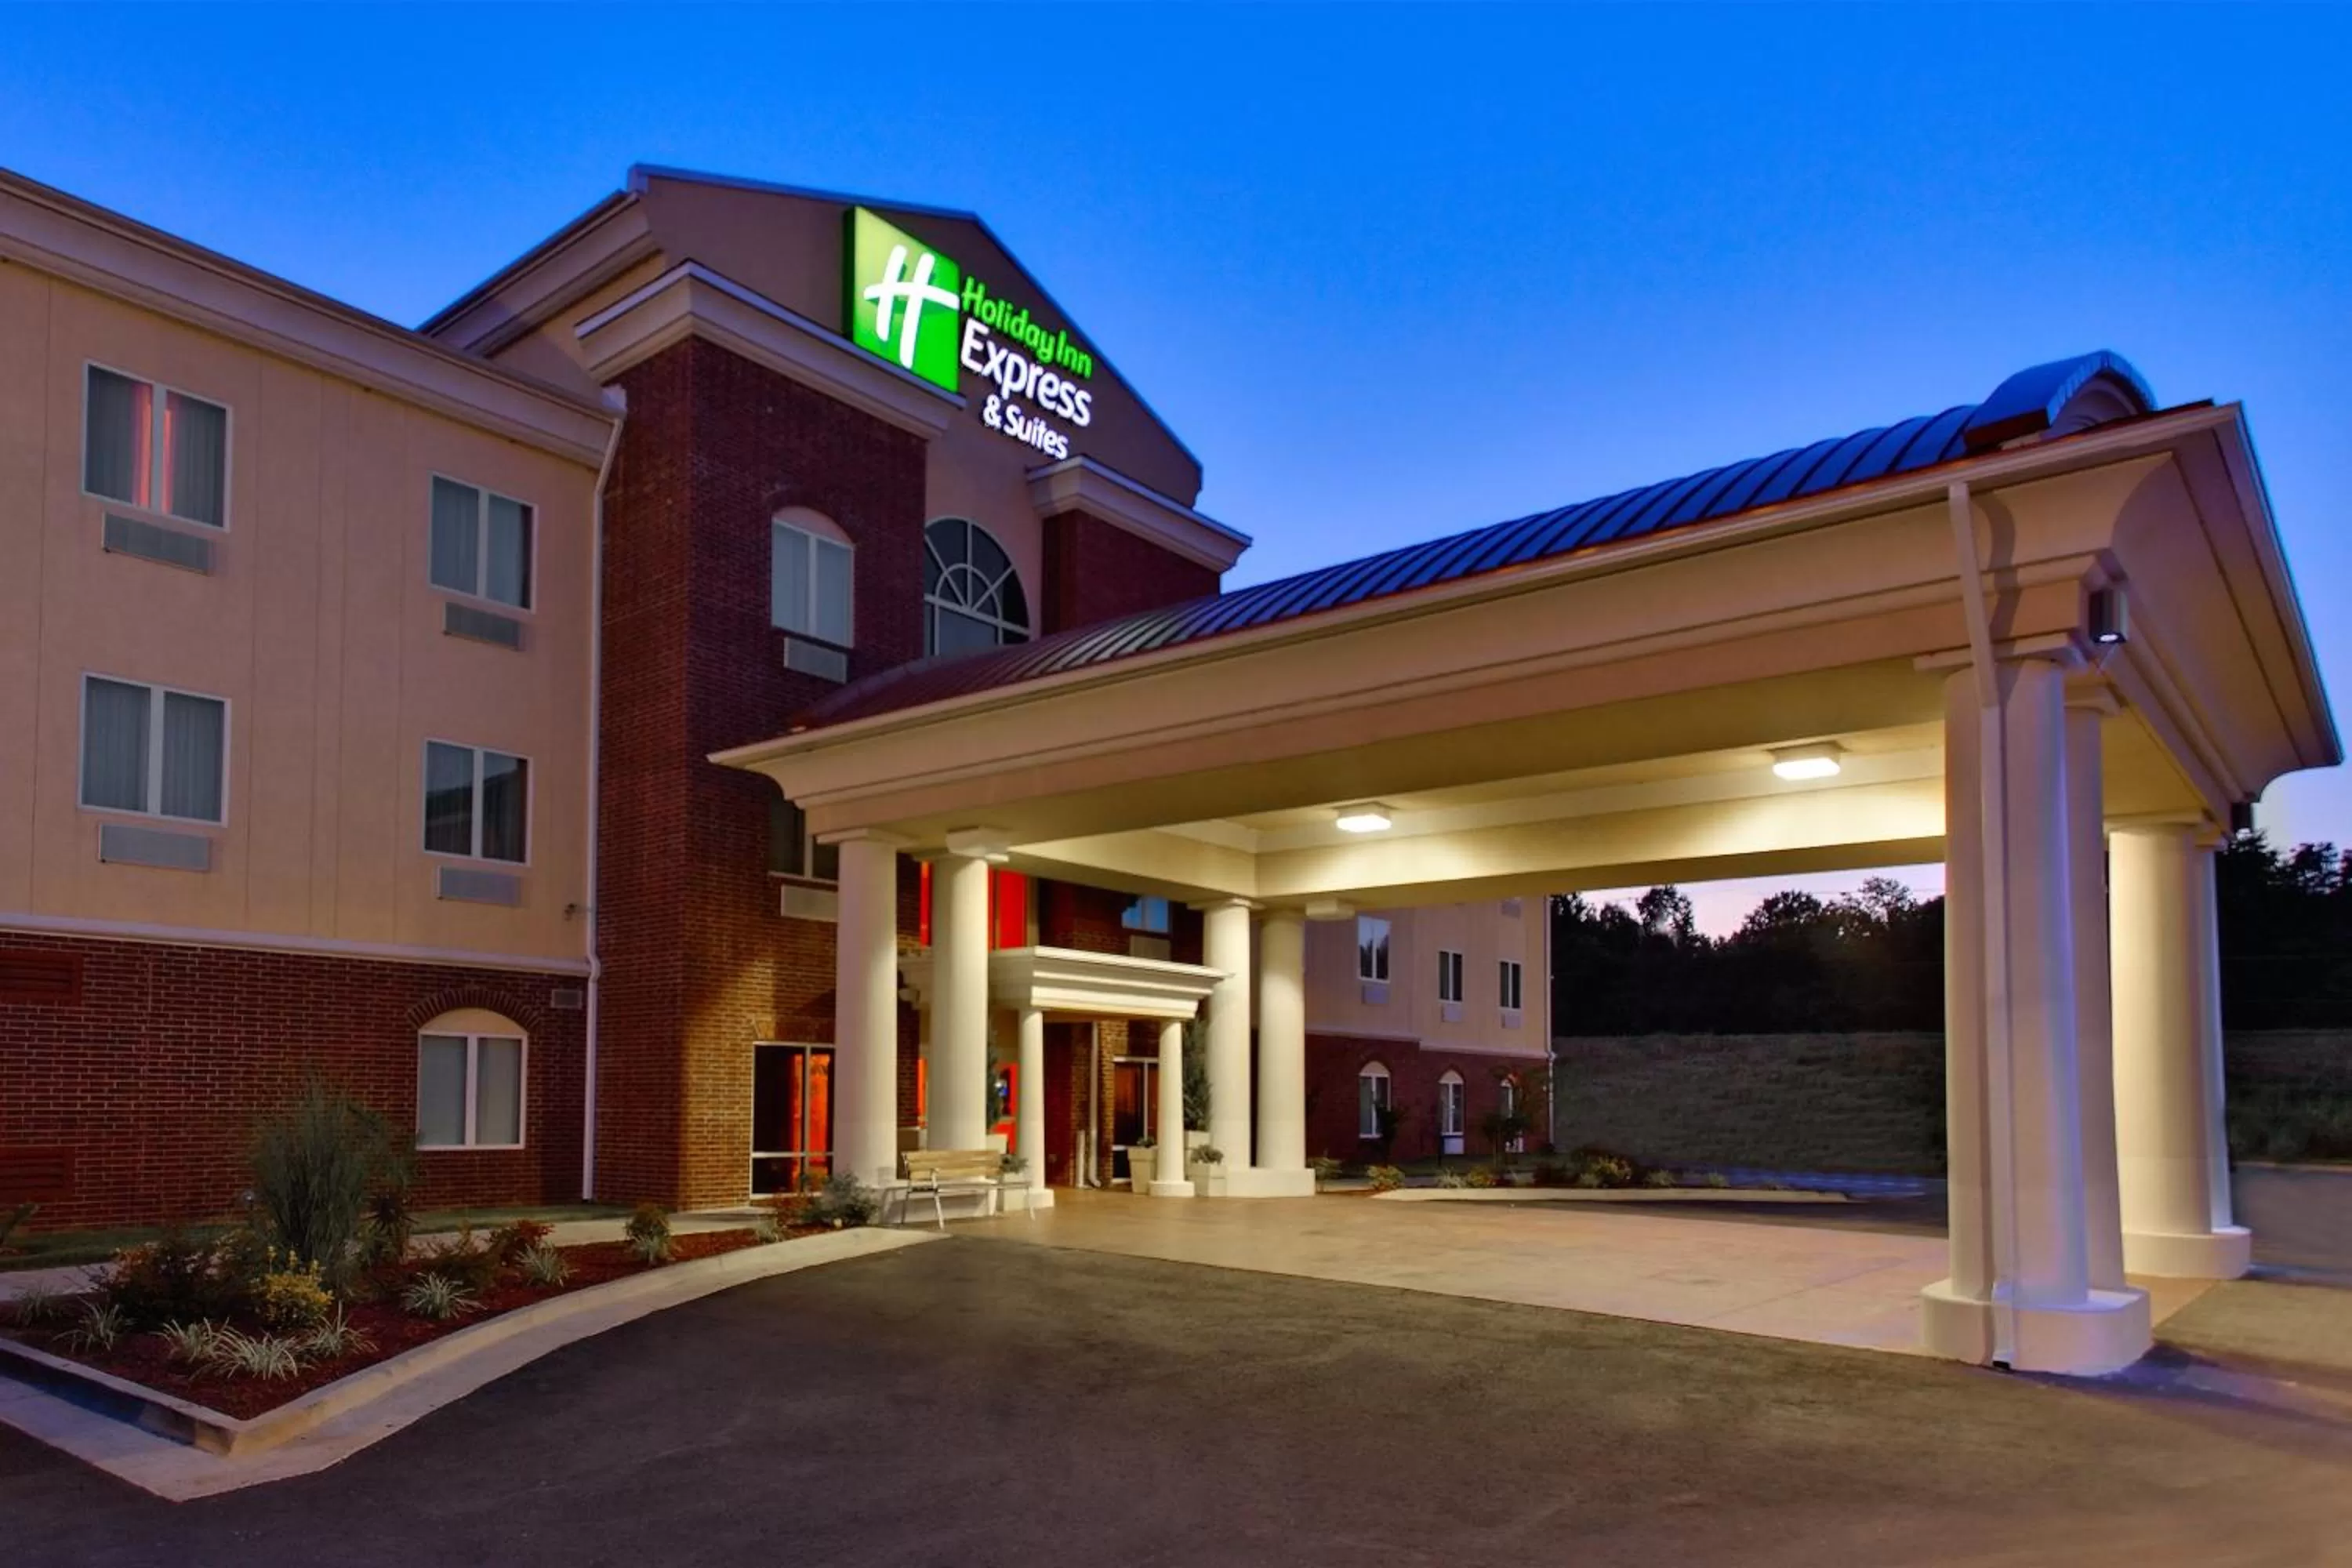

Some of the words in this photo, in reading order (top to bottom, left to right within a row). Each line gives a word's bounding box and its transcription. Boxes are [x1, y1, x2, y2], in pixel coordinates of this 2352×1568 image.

[960, 318, 1092, 427] Express
[961, 276, 1055, 364] Holiday
[1054, 331, 1093, 379] Inn
[982, 394, 1001, 429] &
[1004, 405, 1069, 460] Suites
